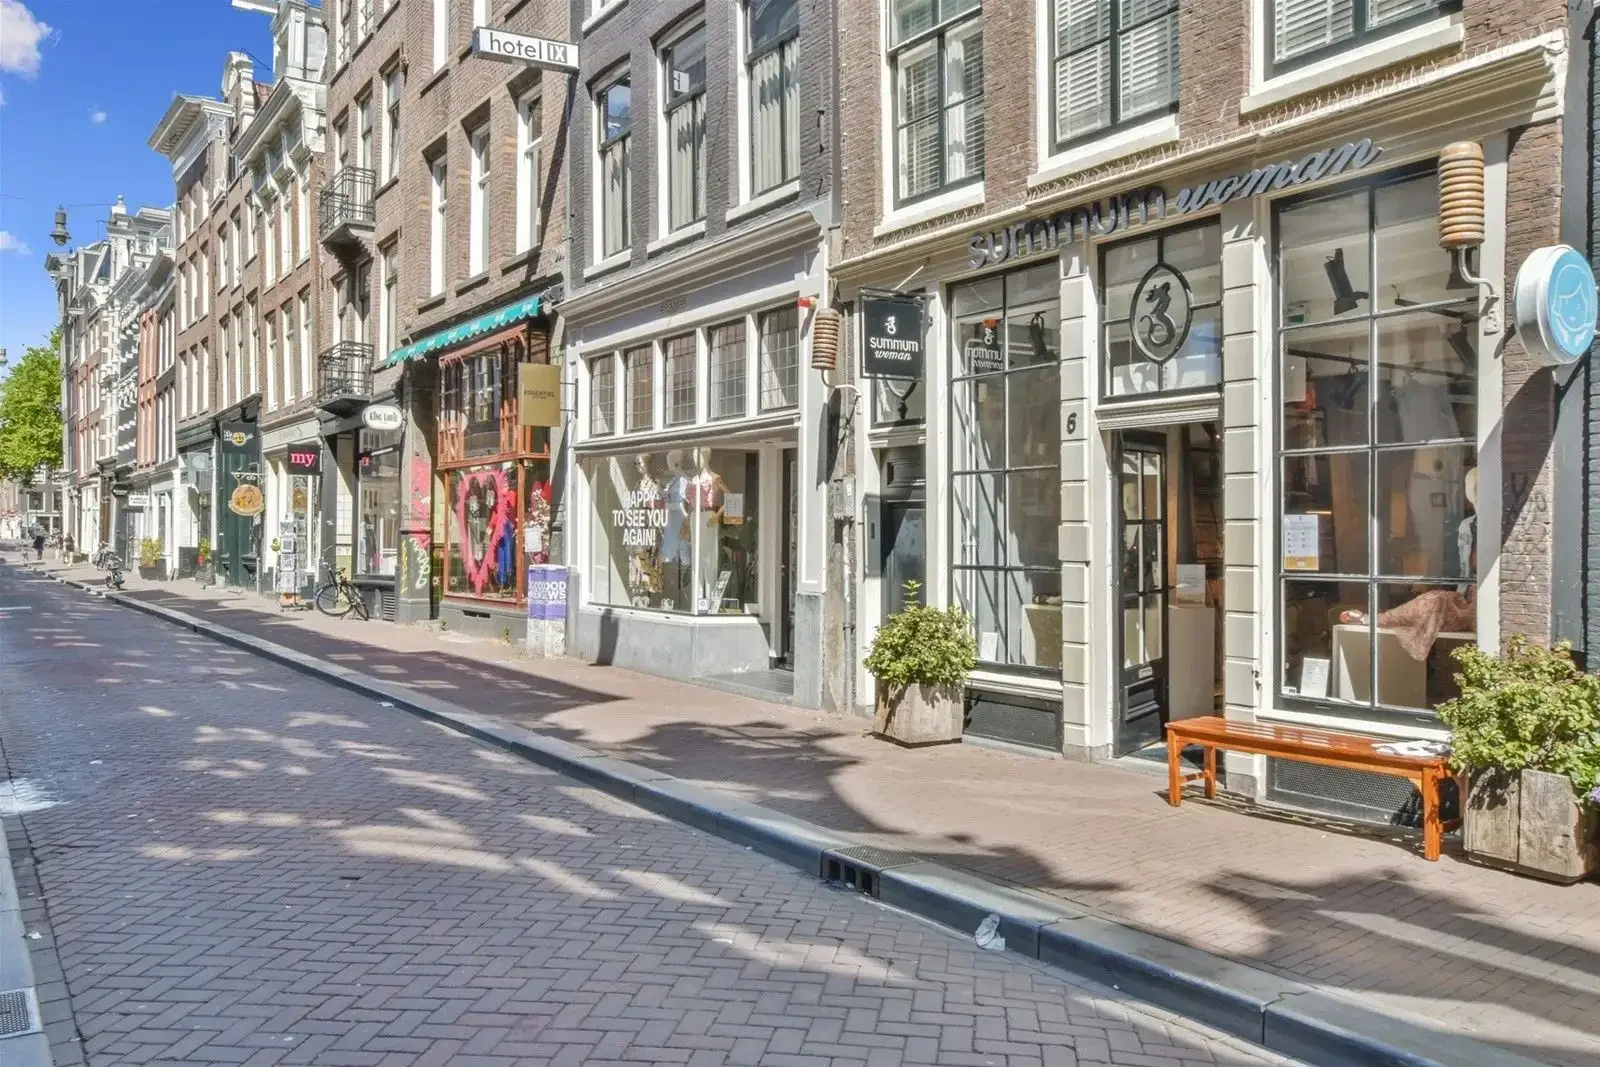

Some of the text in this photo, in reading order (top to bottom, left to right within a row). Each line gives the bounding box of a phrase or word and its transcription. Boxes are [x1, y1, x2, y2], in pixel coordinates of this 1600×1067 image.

[490, 32, 567, 63] hotel IX
[967, 138, 1384, 270] summum woman
[869, 336, 919, 353] summum
[874, 349, 912, 361] woman
[1066, 412, 1077, 434] 6
[290, 452, 316, 468] my
[612, 508, 669, 528] TO SEE YOU
[622, 528, 657, 546] AGAIN!
